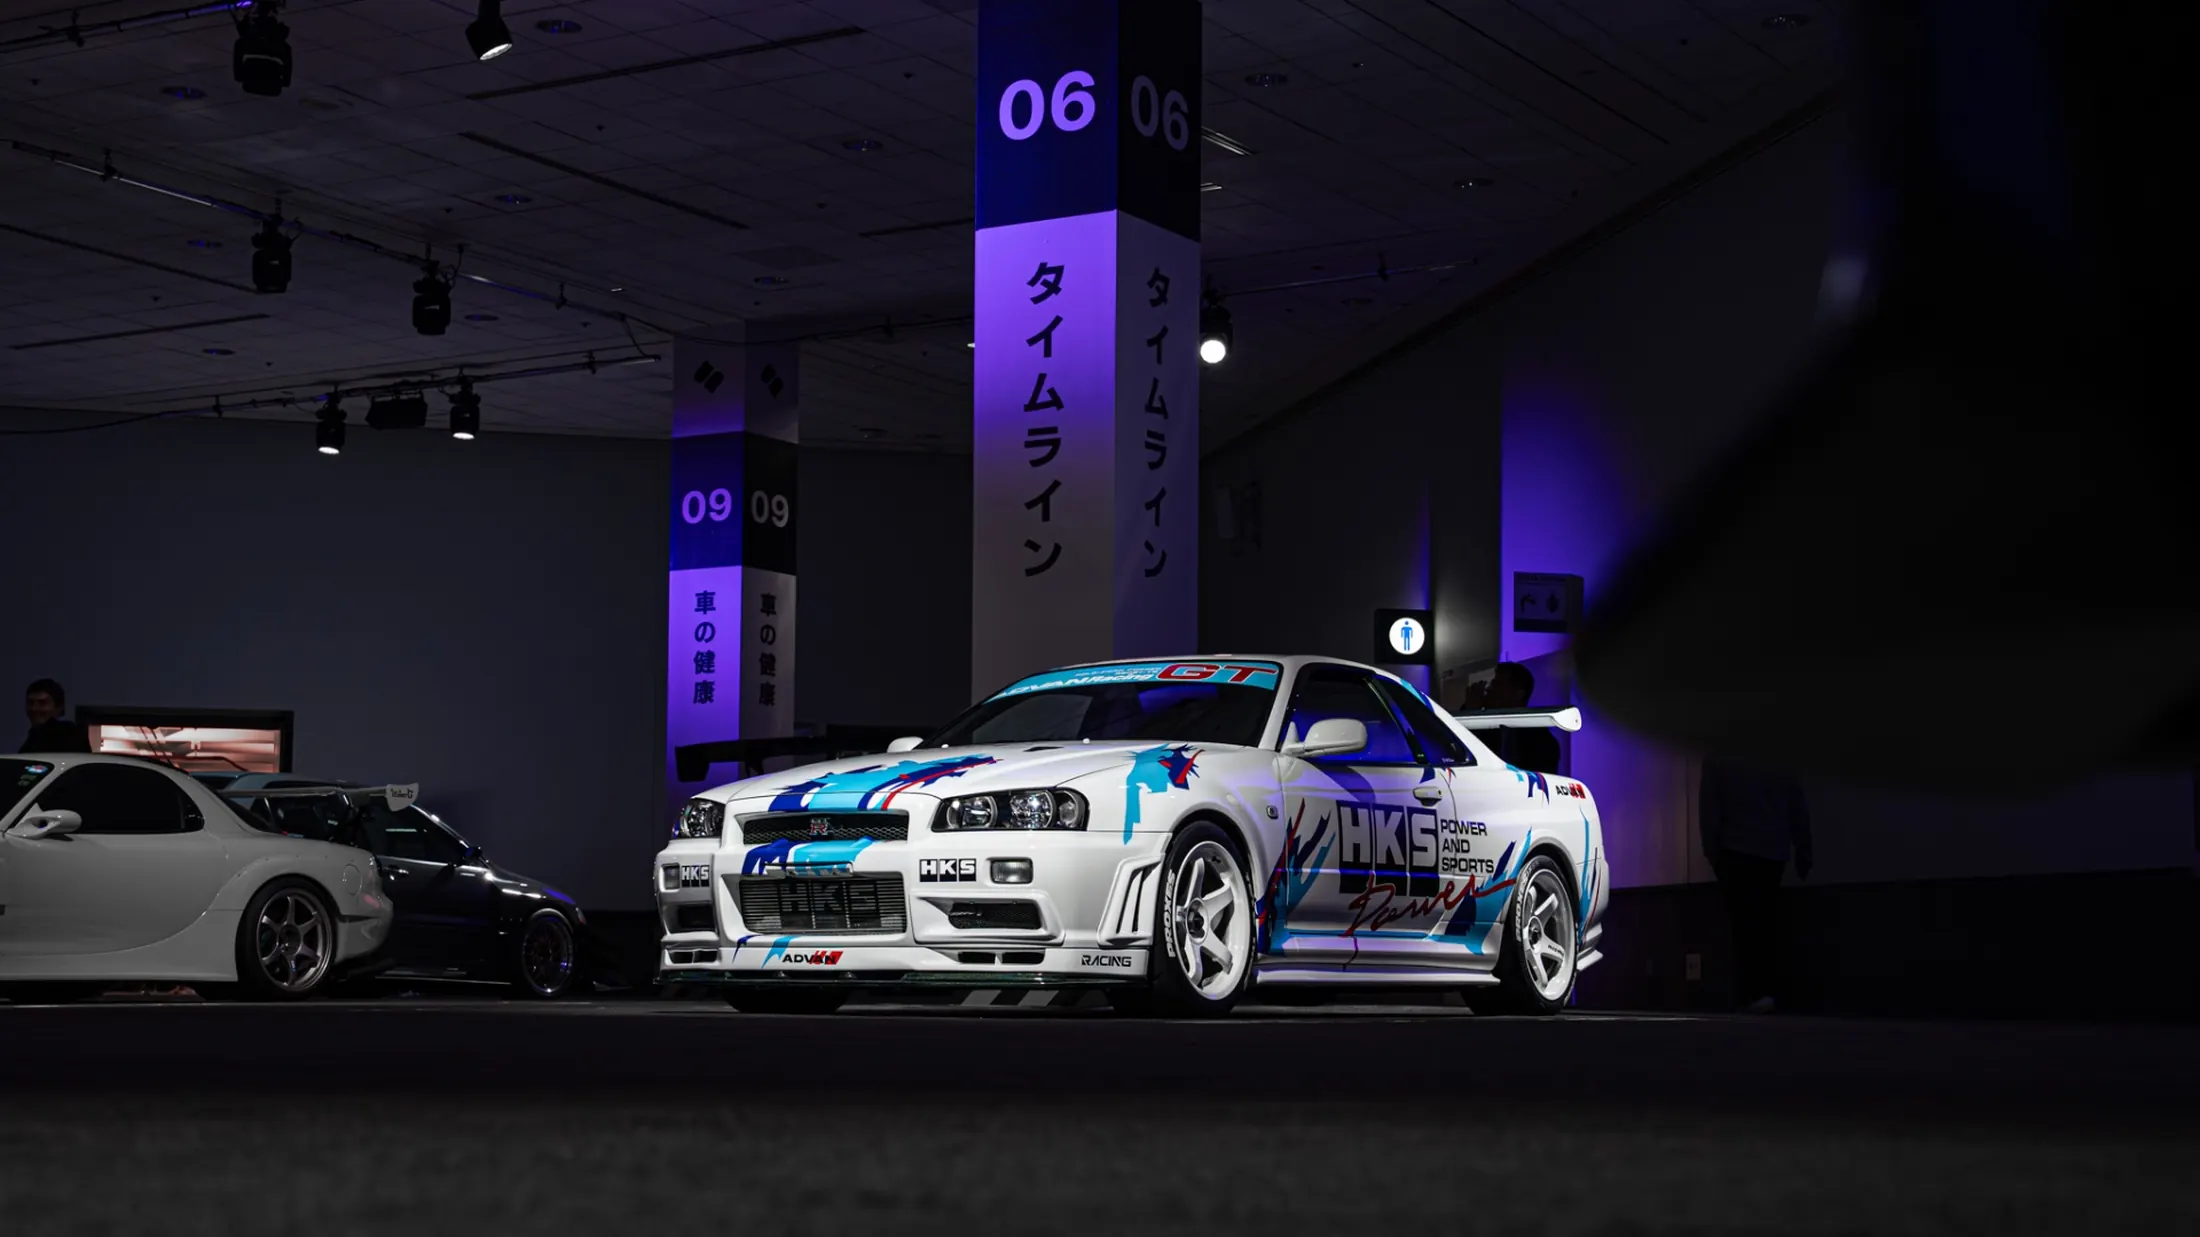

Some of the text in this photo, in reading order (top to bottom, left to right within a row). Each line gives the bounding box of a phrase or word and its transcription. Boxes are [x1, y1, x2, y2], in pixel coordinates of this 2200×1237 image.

[999, 70, 1096, 140] 06
[1131, 75, 1189, 151] 06
[1023, 262, 1065, 577] タイムライン
[1144, 267, 1170, 578] タイムライン
[681, 488, 733, 524] 09
[750, 490, 789, 528] 09
[693, 590, 717, 704] 車の健康
[759, 593, 777, 706] 車の健康
[1157, 663, 1279, 683] GT
[1339, 804, 1437, 868] HKS
[1440, 819, 1488, 836] POWER
[1442, 837, 1471, 853] AND
[681, 865, 709, 882] HKS
[920, 859, 975, 877] HKS
[1441, 857, 1495, 873] SPORTS
[1164, 869, 1176, 958] PROXES
[782, 951, 842, 965] ADVAN
[1081, 955, 1132, 967] RACING
